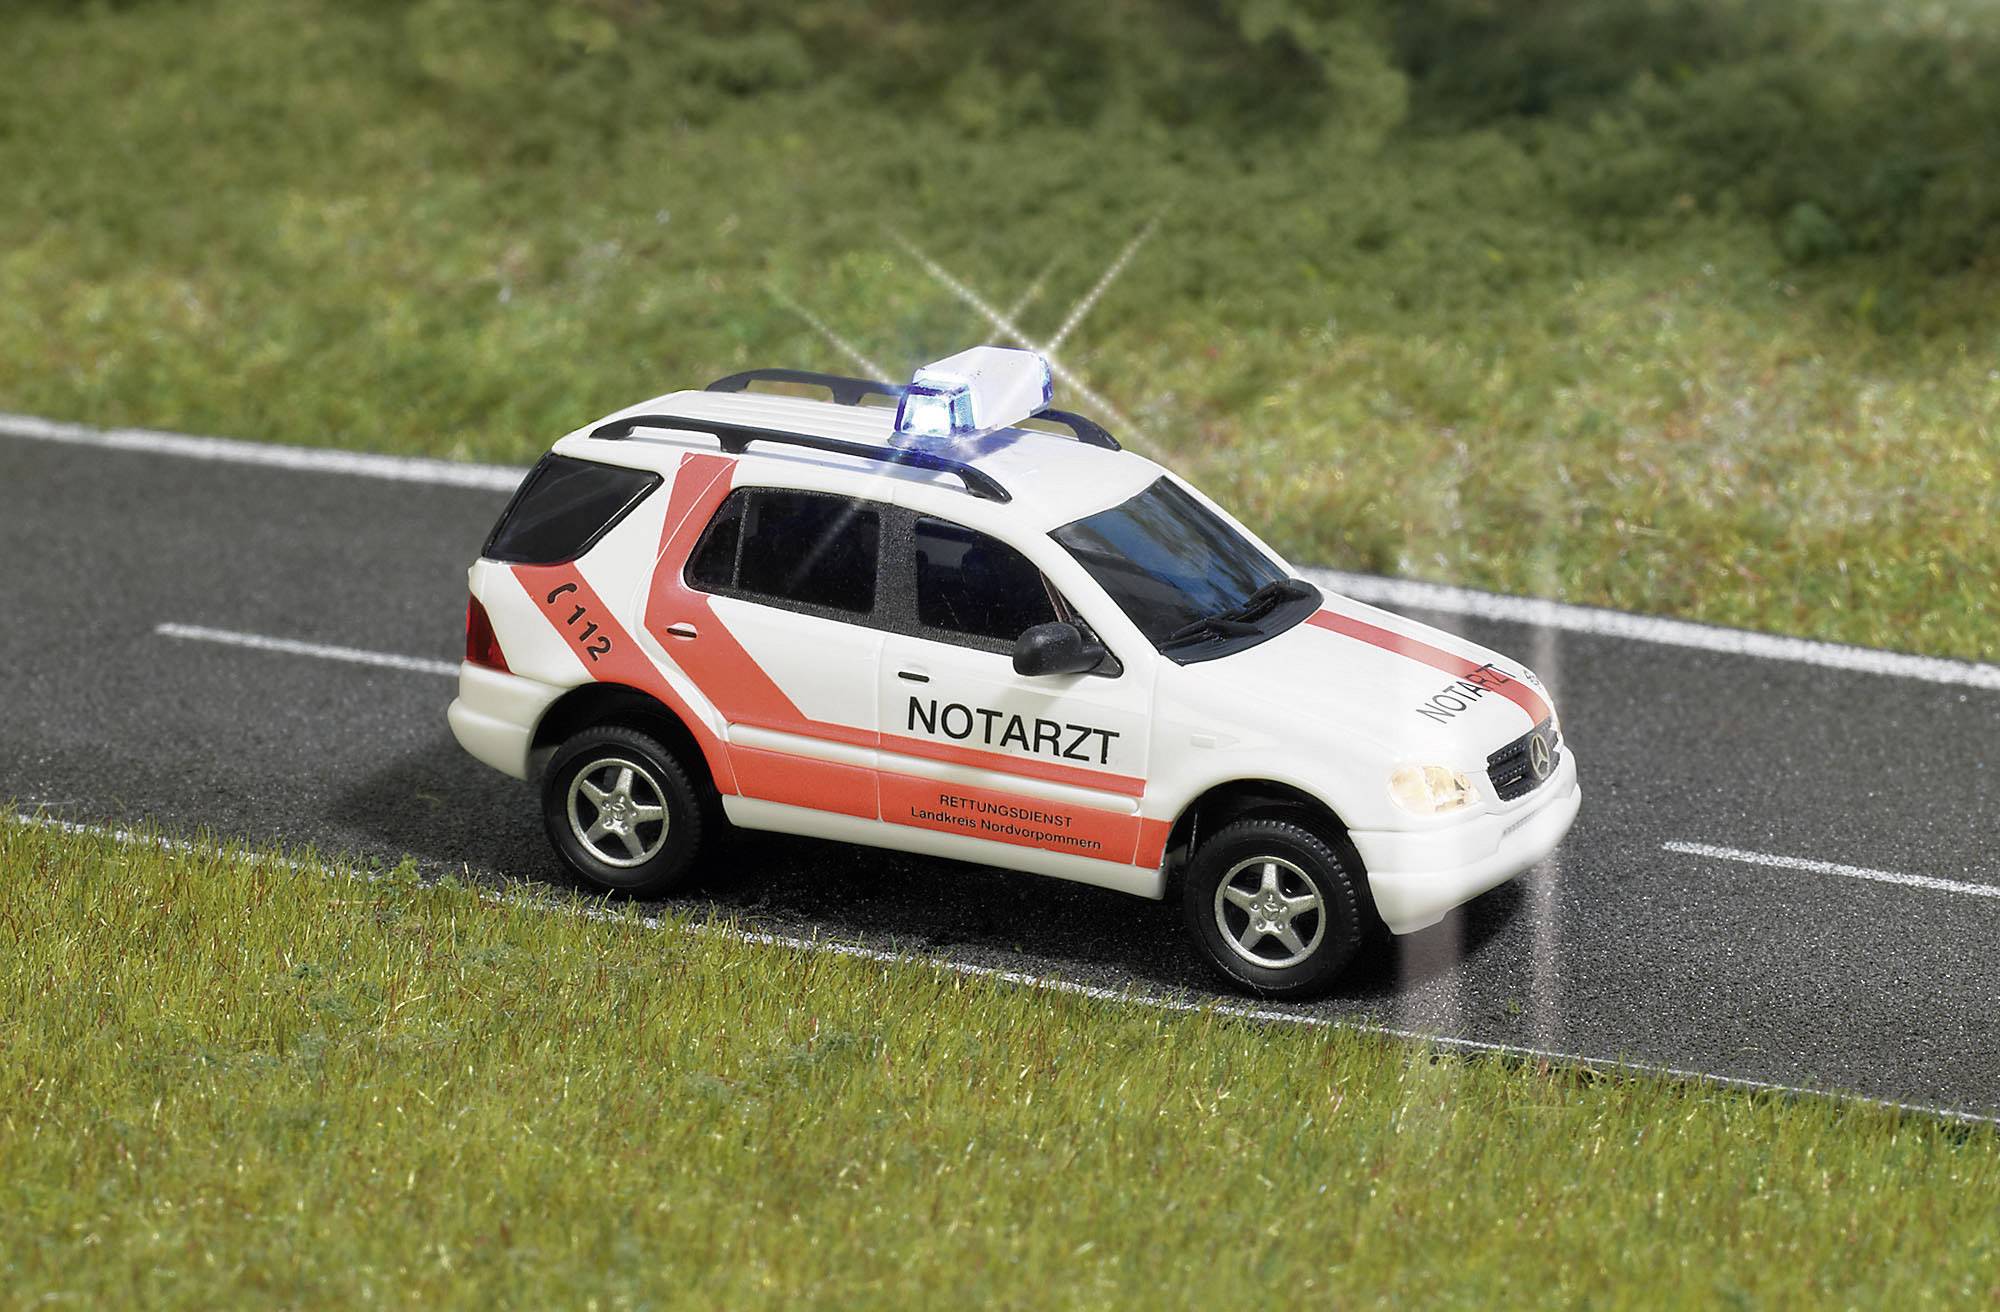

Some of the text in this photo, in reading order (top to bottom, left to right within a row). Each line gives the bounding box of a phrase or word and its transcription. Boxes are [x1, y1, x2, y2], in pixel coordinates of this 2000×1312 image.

[567, 604, 612, 662] 112
[1416, 663, 1516, 724] NOTARZT
[907, 696, 1120, 764] NOTARZT
[911, 807, 1102, 850] Landkreis Nordvorpommern
[940, 794, 1073, 828] RETTUNGSDIENST
